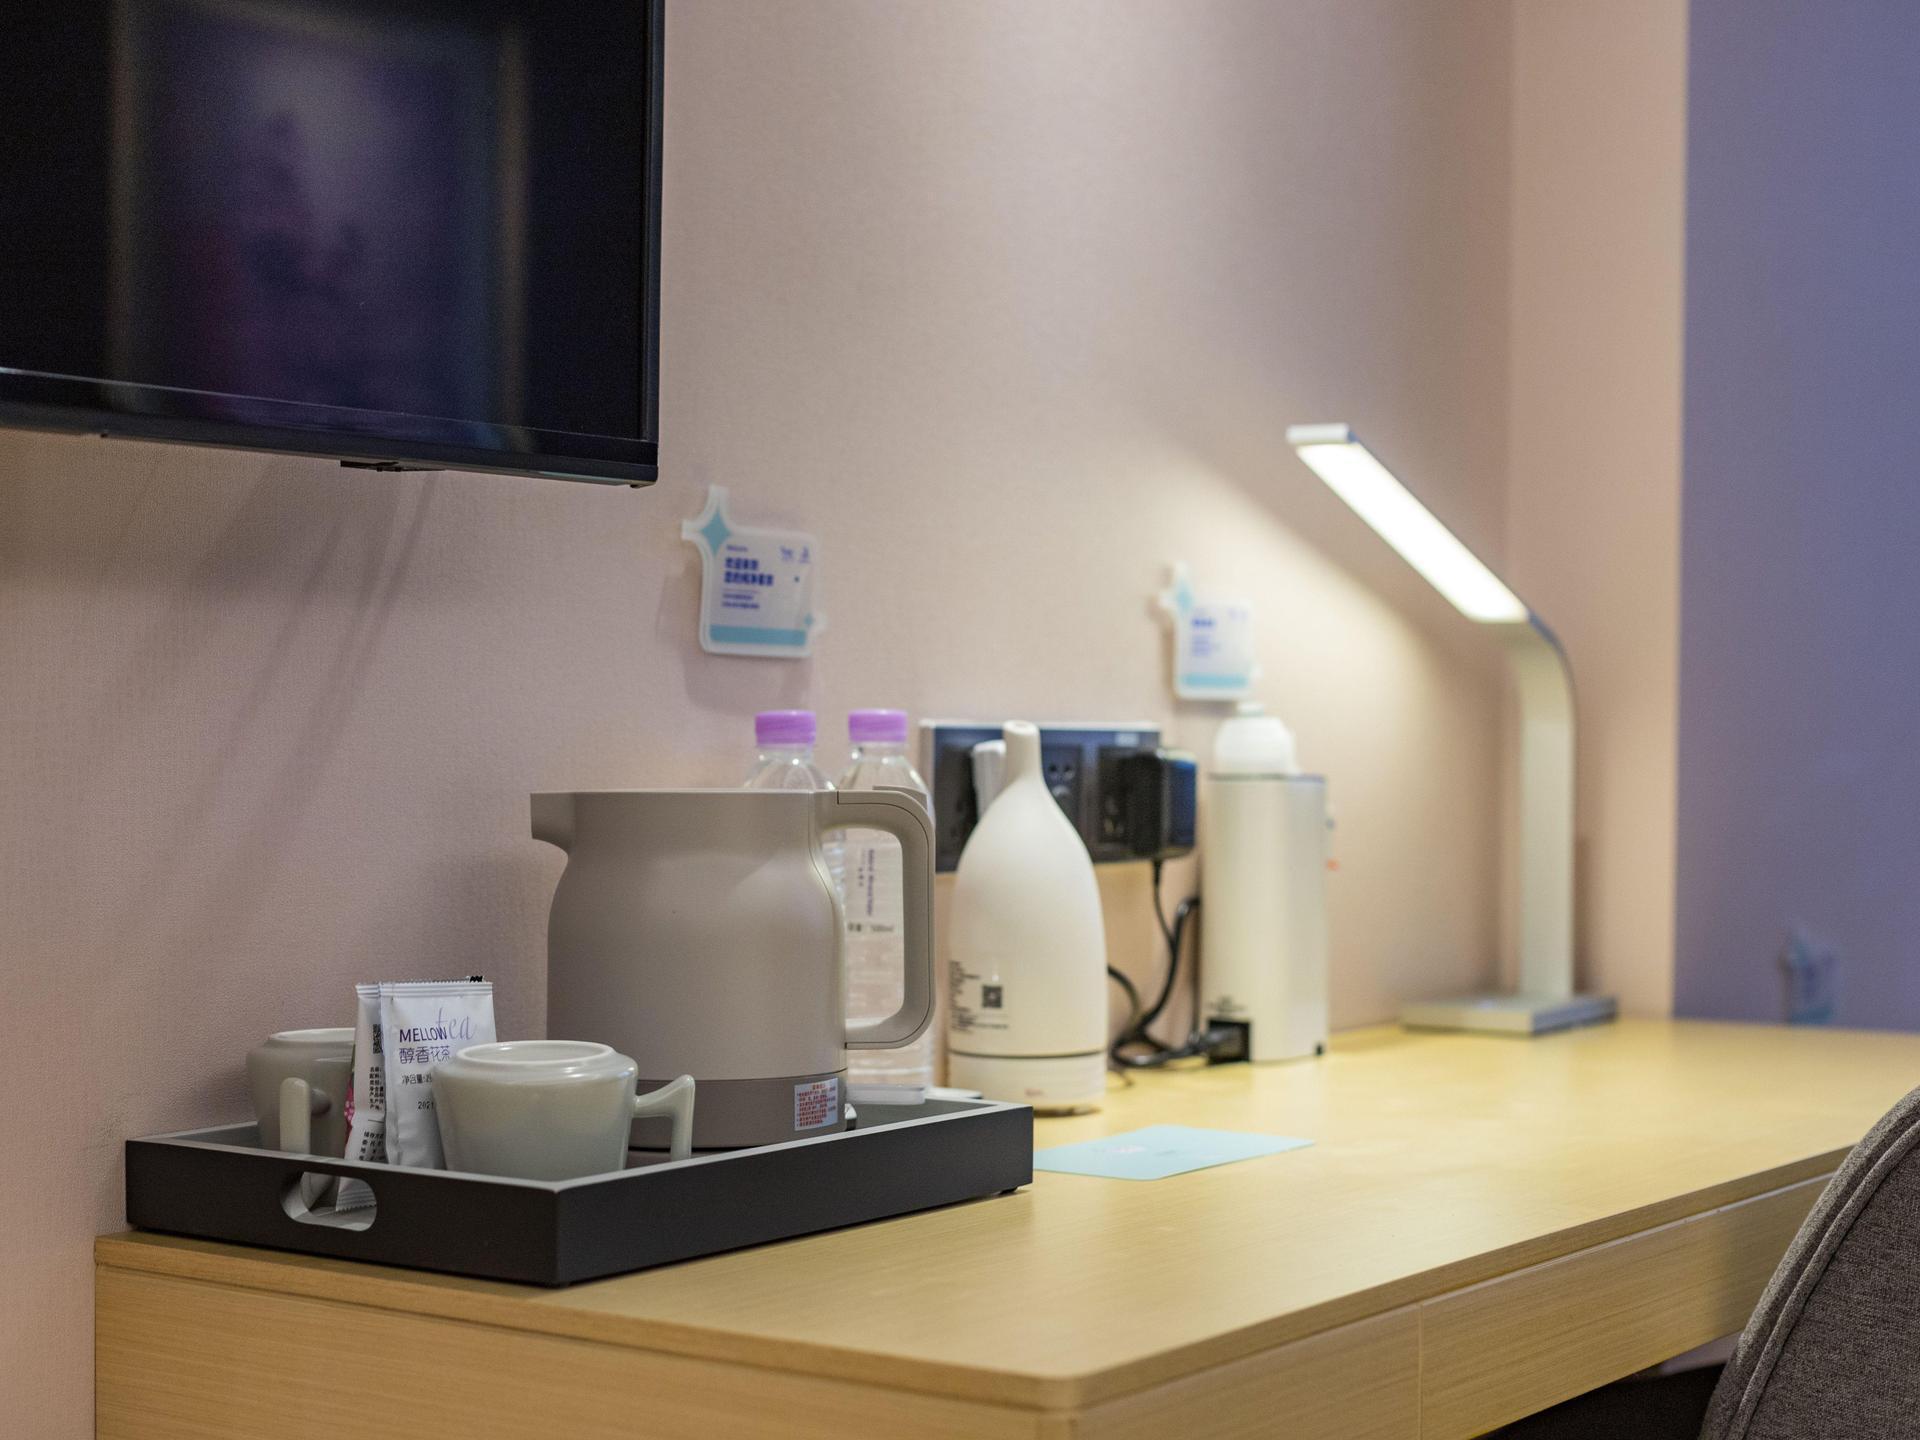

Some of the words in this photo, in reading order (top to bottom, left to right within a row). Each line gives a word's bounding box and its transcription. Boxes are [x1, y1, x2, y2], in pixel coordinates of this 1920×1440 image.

[436, 1006, 475, 1040] tea
[399, 1026, 448, 1043] MELLOW
[398, 1045, 451, 1065] 醇香花茶
